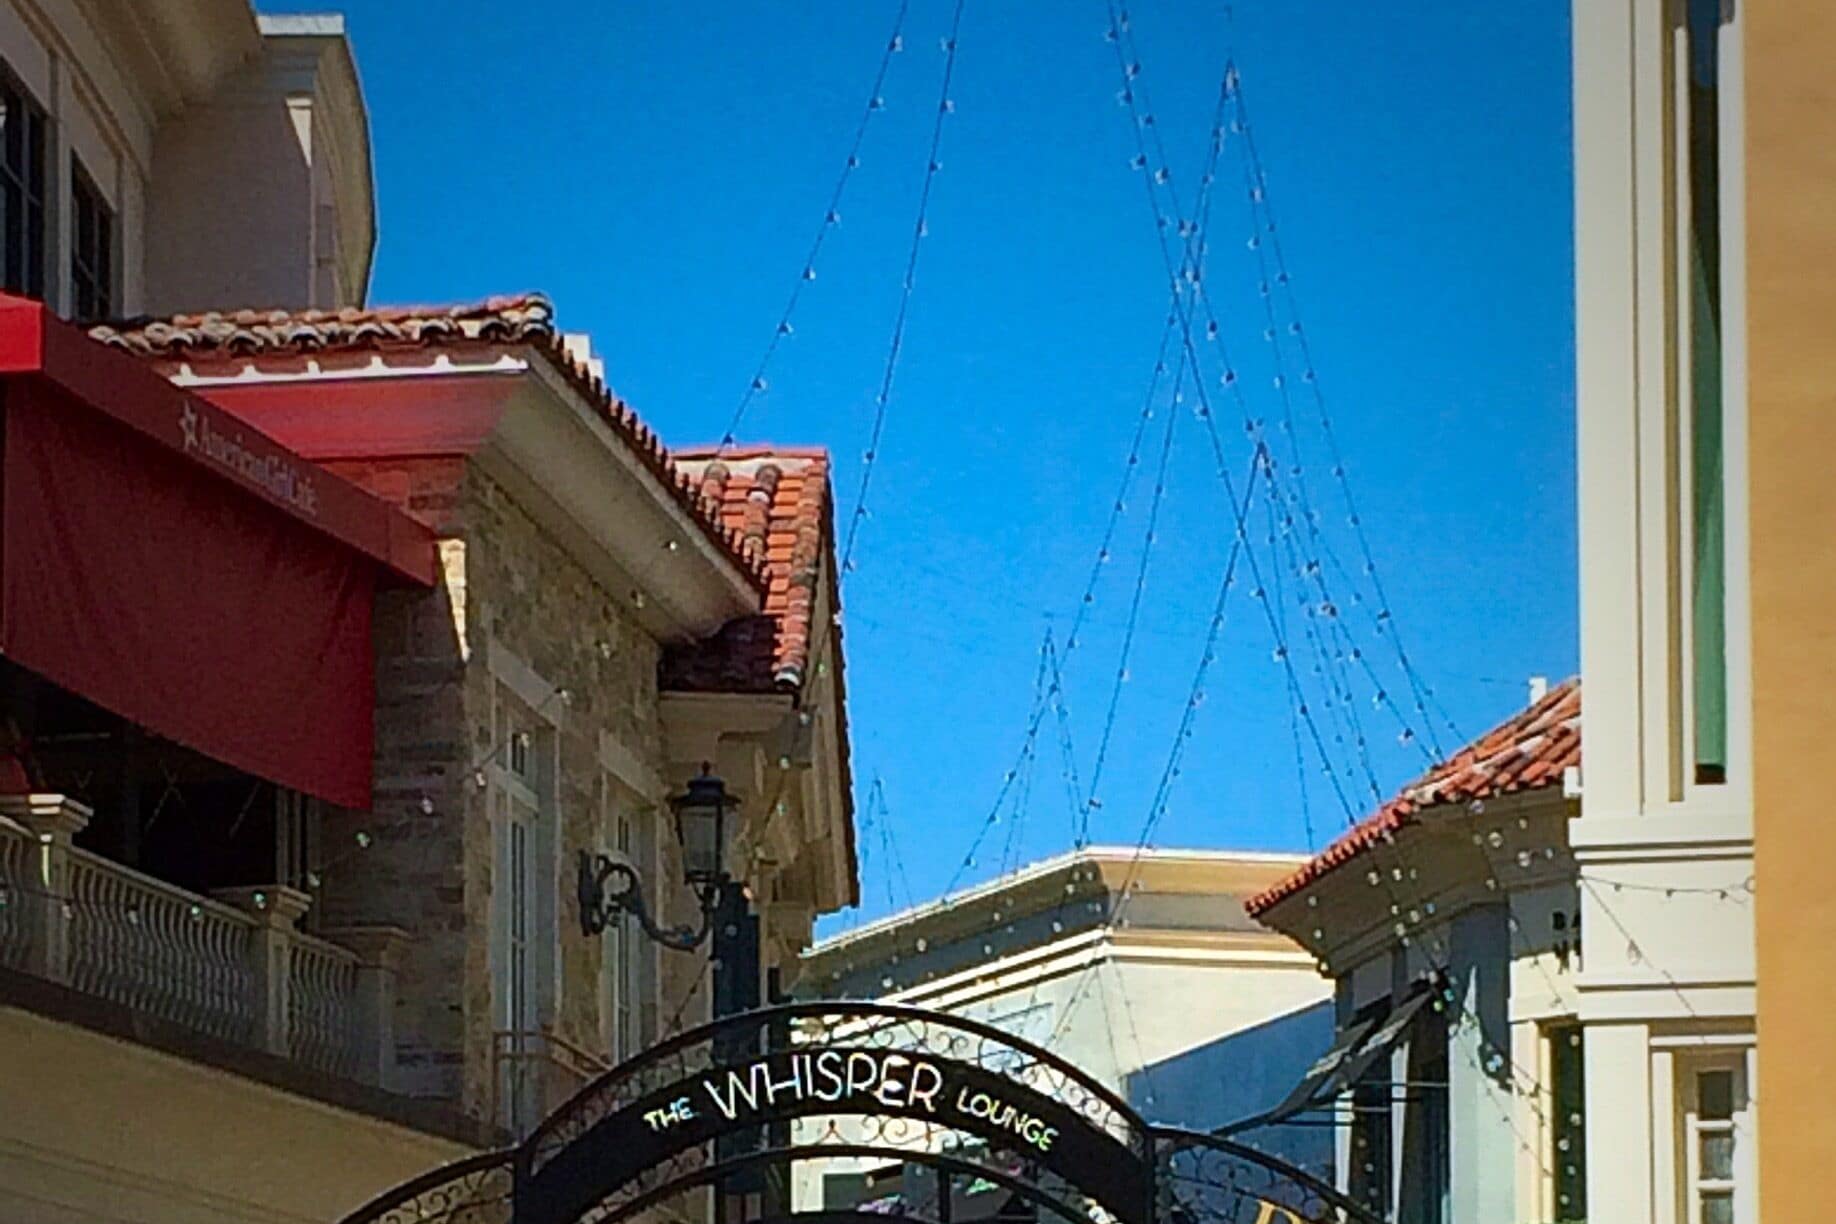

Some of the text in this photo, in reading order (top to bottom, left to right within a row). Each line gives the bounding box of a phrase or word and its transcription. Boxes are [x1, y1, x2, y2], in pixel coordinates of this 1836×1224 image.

[643, 1052, 1059, 1151] THE WHISPER LOUNGE
